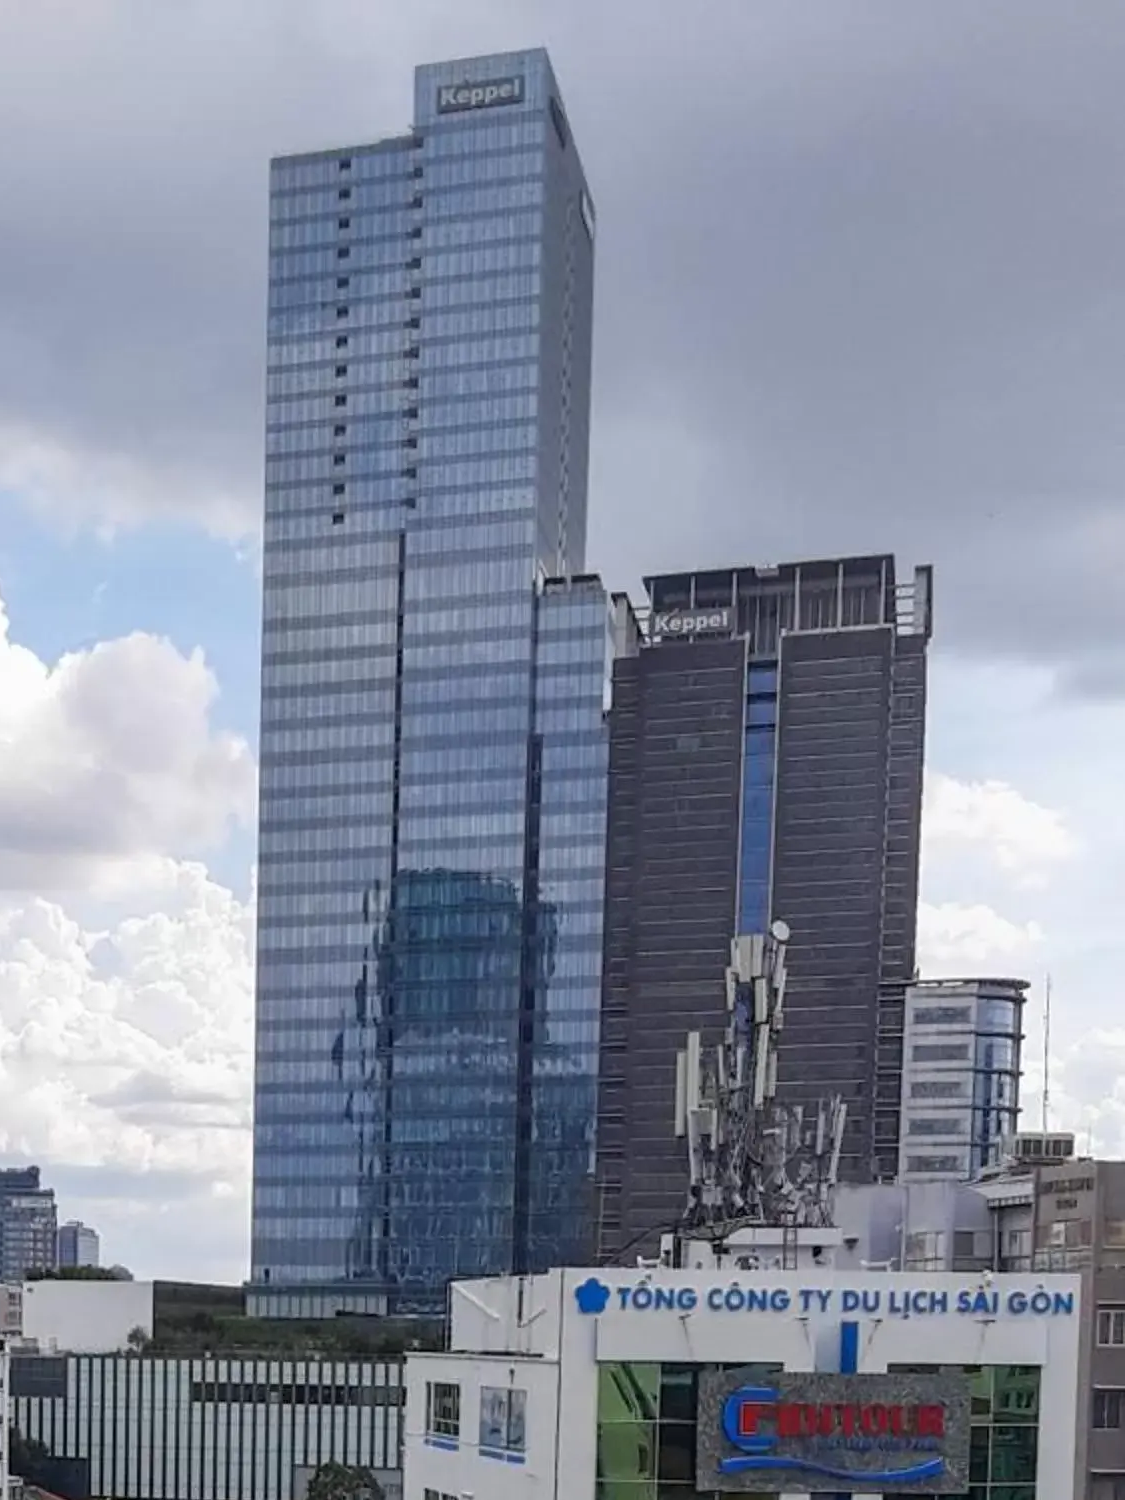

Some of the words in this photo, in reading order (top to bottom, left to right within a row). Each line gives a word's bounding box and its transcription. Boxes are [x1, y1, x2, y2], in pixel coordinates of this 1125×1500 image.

[441, 78, 520, 106] Keppel
[654, 611, 728, 633] Keppel
[617, 1275, 698, 1311] TỔNG
[707, 1281, 791, 1312] CÔNG
[799, 1289, 832, 1312] TY
[842, 1289, 881, 1313] DU
[889, 1289, 948, 1320] LỊCH
[1007, 1284, 1074, 1315] GÒN
